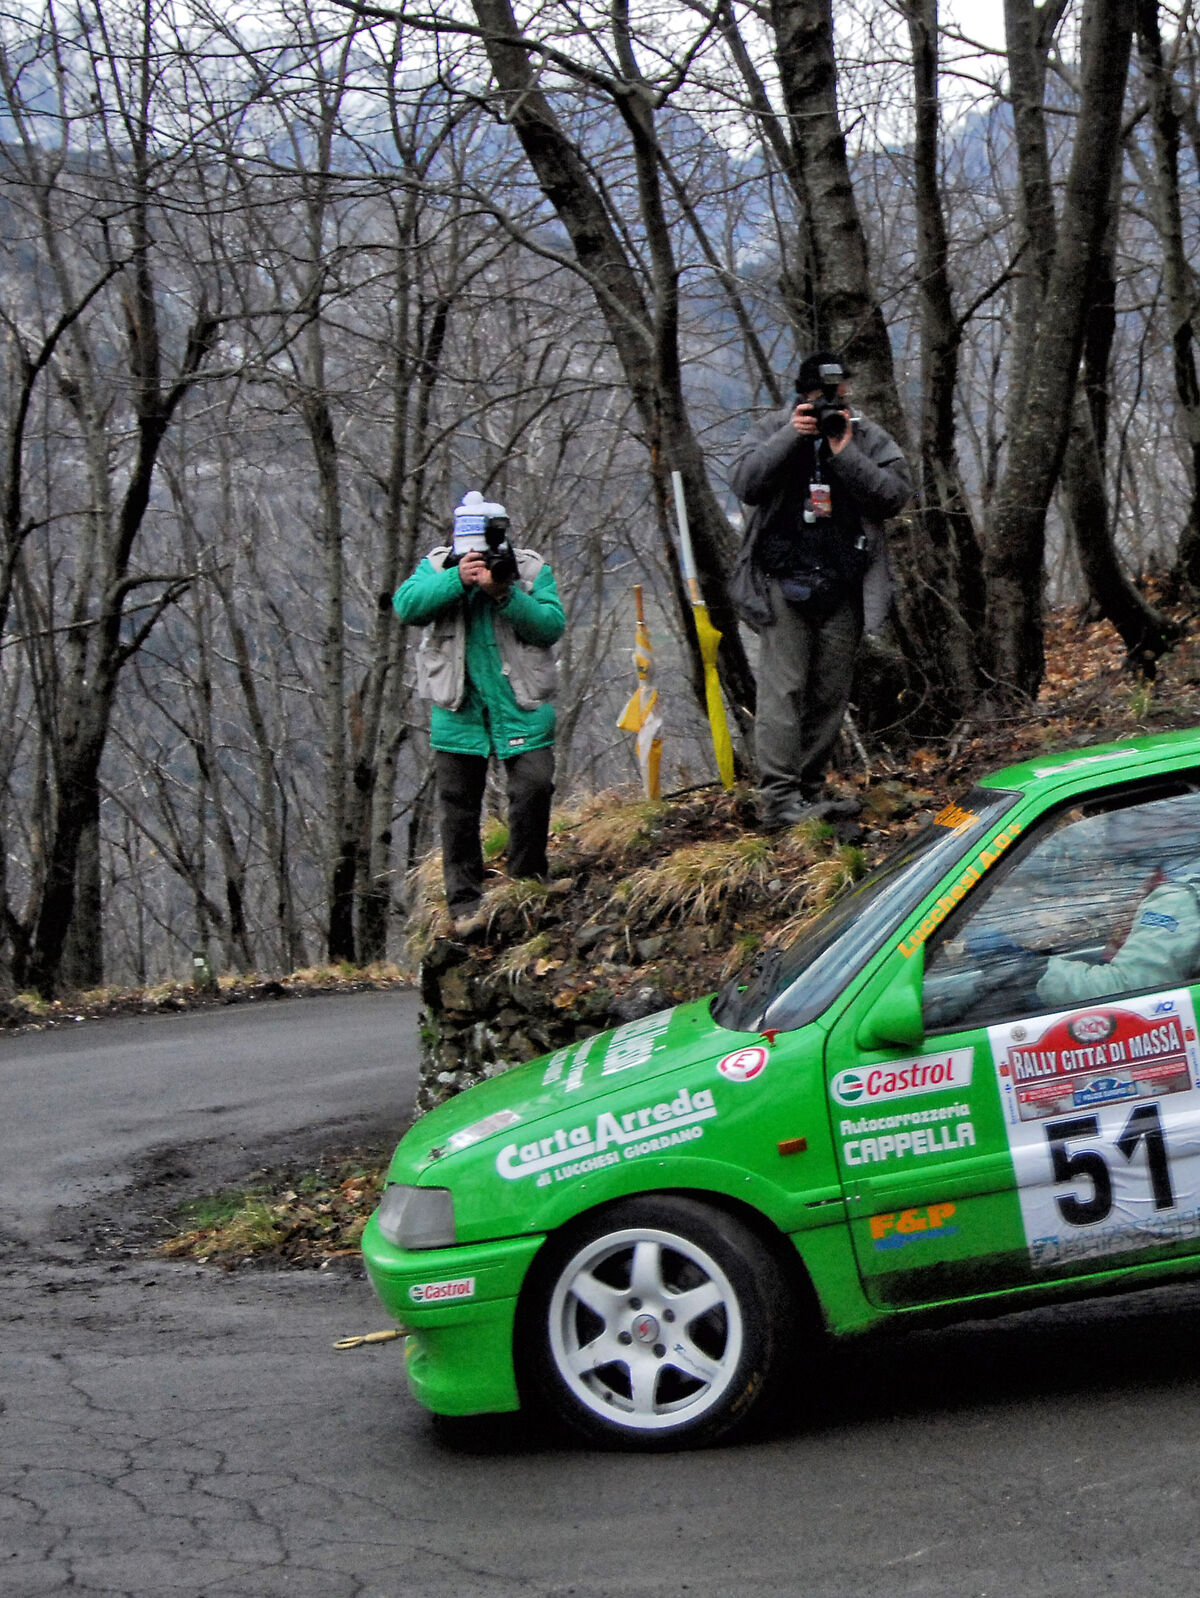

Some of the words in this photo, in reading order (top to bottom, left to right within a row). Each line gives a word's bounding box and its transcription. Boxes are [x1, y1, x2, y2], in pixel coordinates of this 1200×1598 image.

[897, 866, 982, 958] Lucchesi
[1013, 1051, 1057, 1080] RALLY
[1110, 1041, 1126, 1062] DI
[1128, 1022, 1181, 1058] MASSA
[867, 1058, 954, 1096] Castrol
[840, 1102, 971, 1136] Autocarrozzeria
[536, 1172, 552, 1187] di
[555, 1151, 620, 1181] LUCCHESI
[624, 1126, 704, 1158] GIORDANO
[844, 1123, 976, 1166] CAPPELLA
[1042, 1101, 1177, 1228] 51
[870, 1203, 956, 1239] F&P
[425, 1281, 471, 1299] Castrol
